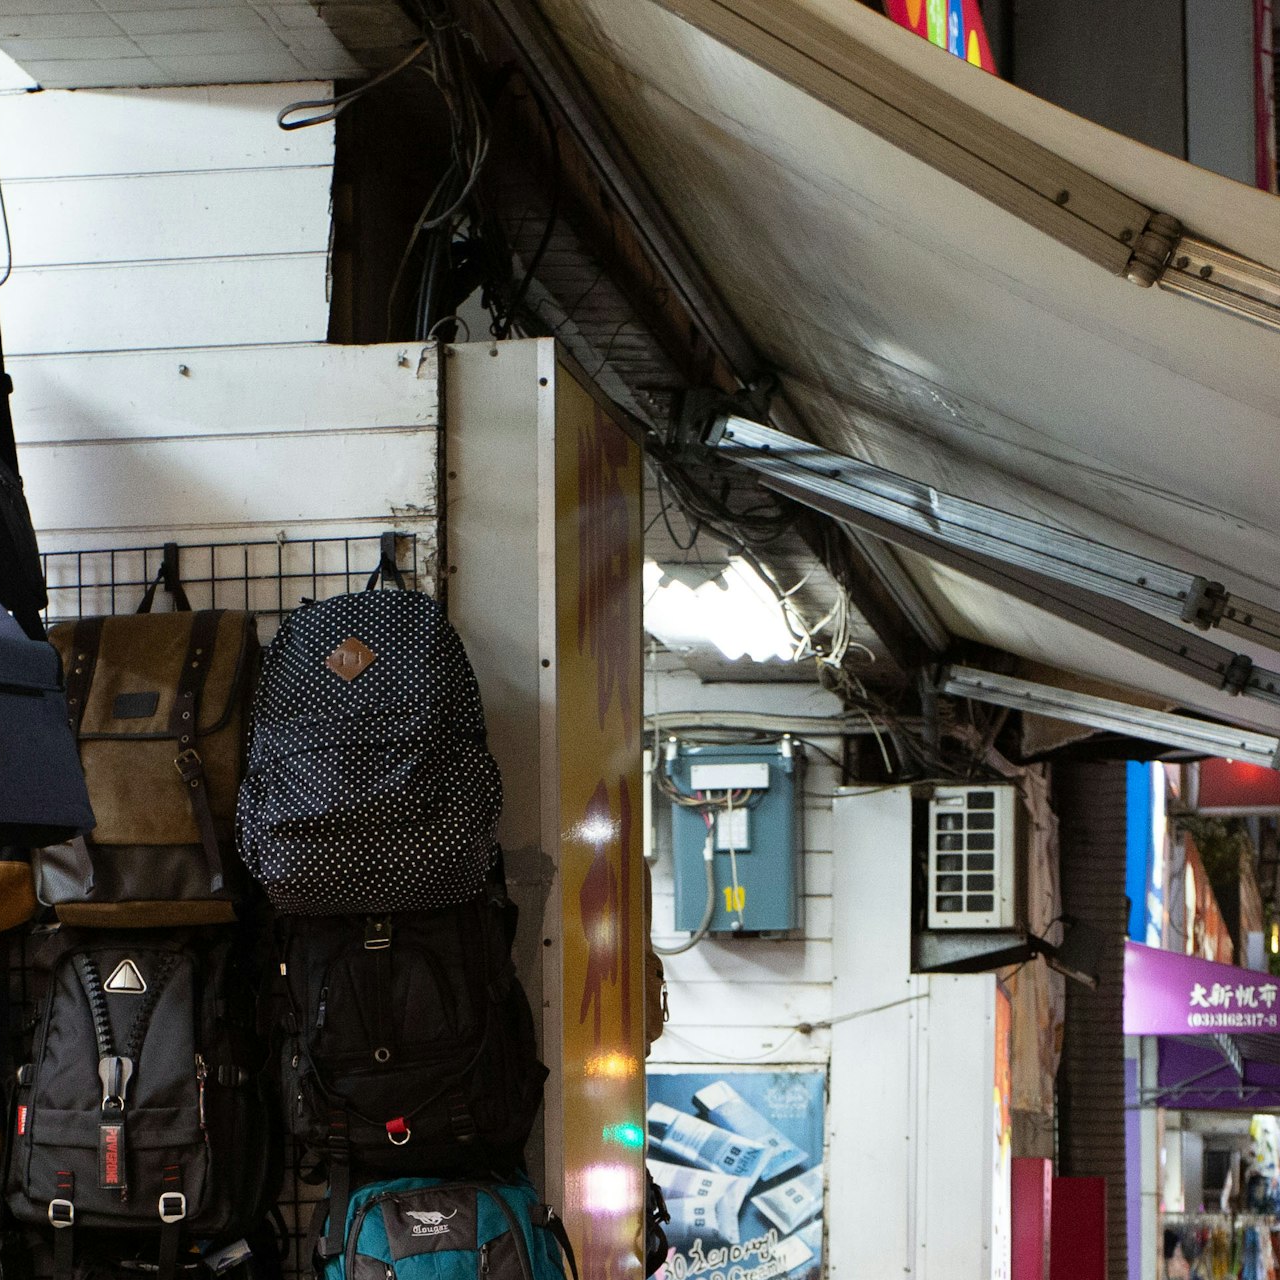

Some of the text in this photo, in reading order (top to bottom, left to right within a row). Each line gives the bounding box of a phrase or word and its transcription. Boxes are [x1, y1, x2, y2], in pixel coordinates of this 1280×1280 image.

[1189, 983, 1278, 1009] 大新帆布
[105, 1128, 118, 1184] POWERONE
[411, 1223, 450, 1236] Cougar
